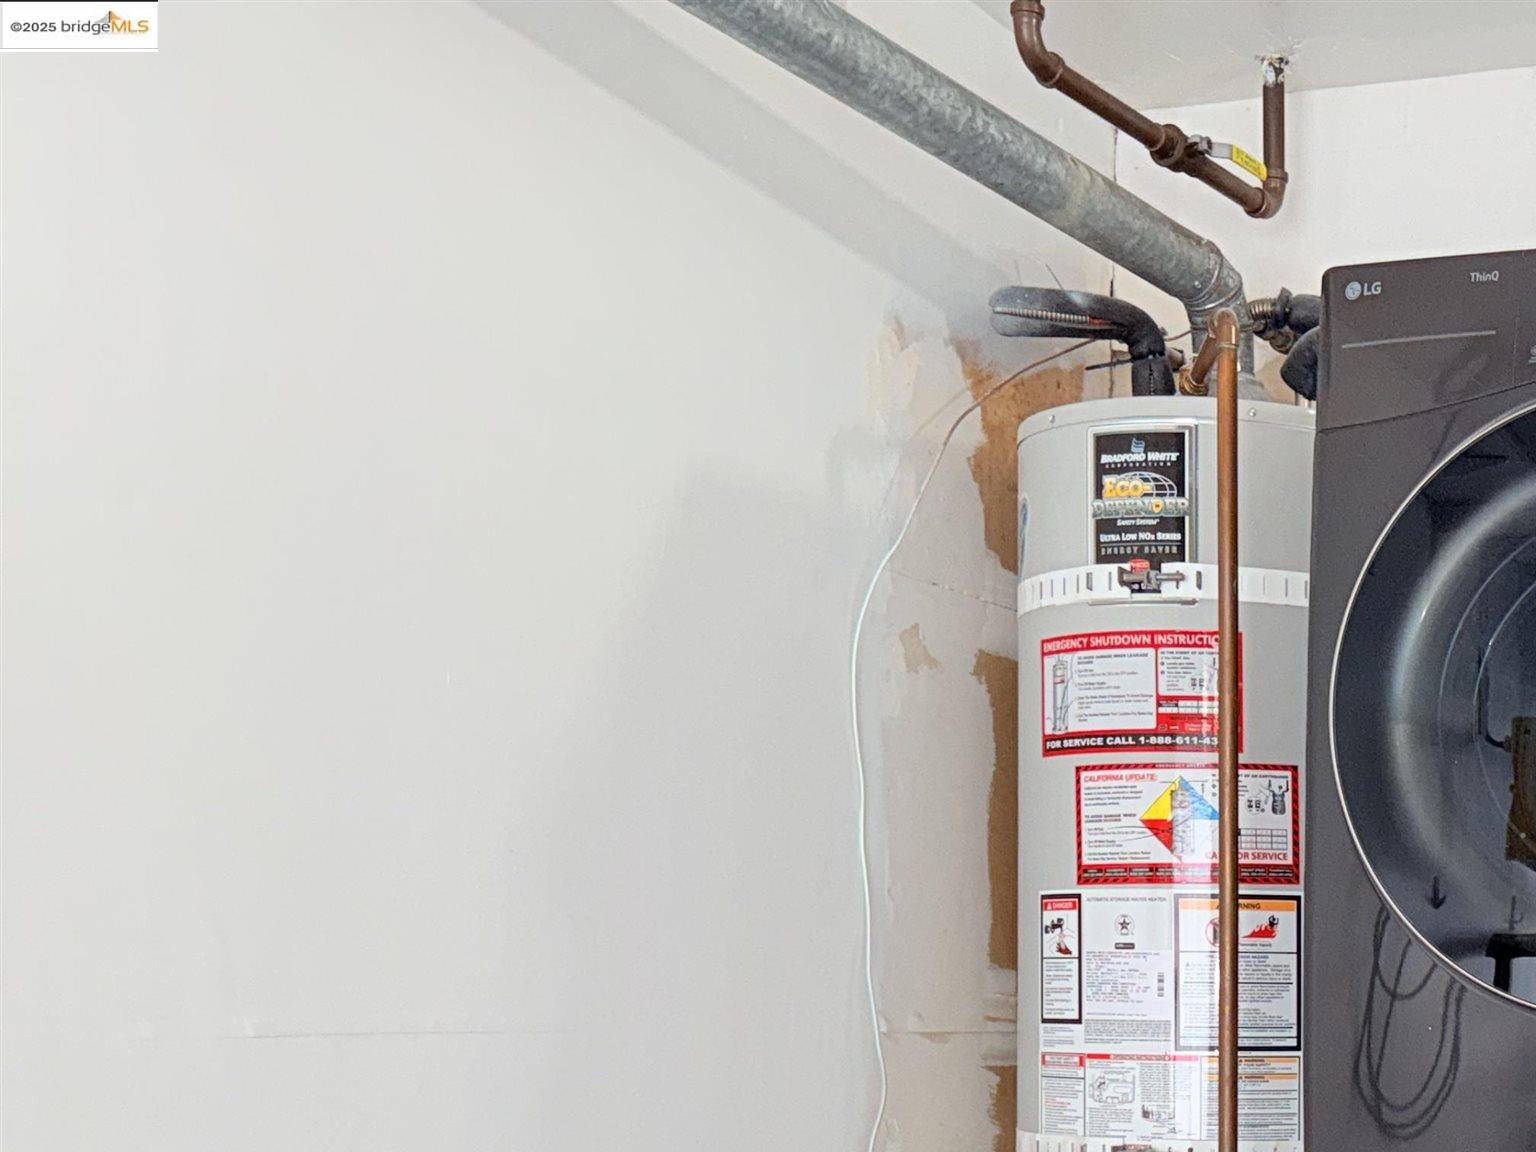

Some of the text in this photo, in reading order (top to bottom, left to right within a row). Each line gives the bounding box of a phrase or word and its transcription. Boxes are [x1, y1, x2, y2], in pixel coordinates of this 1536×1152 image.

[1469, 270, 1499, 282] ThinQ
[1363, 281, 1382, 296] LG
[1100, 451, 1180, 464] BRADFORD WHITE
[1043, 632, 1219, 653] EMERGENCY SHUTDOWN INSTRUCTIO
[1046, 735, 1219, 749] FOR SERVICE CALL 1-888-611-43
[1084, 773, 1124, 782] CALIFORNIA
[1251, 851, 1288, 861] SERVICE
[1052, 901, 1074, 910] DANGER
